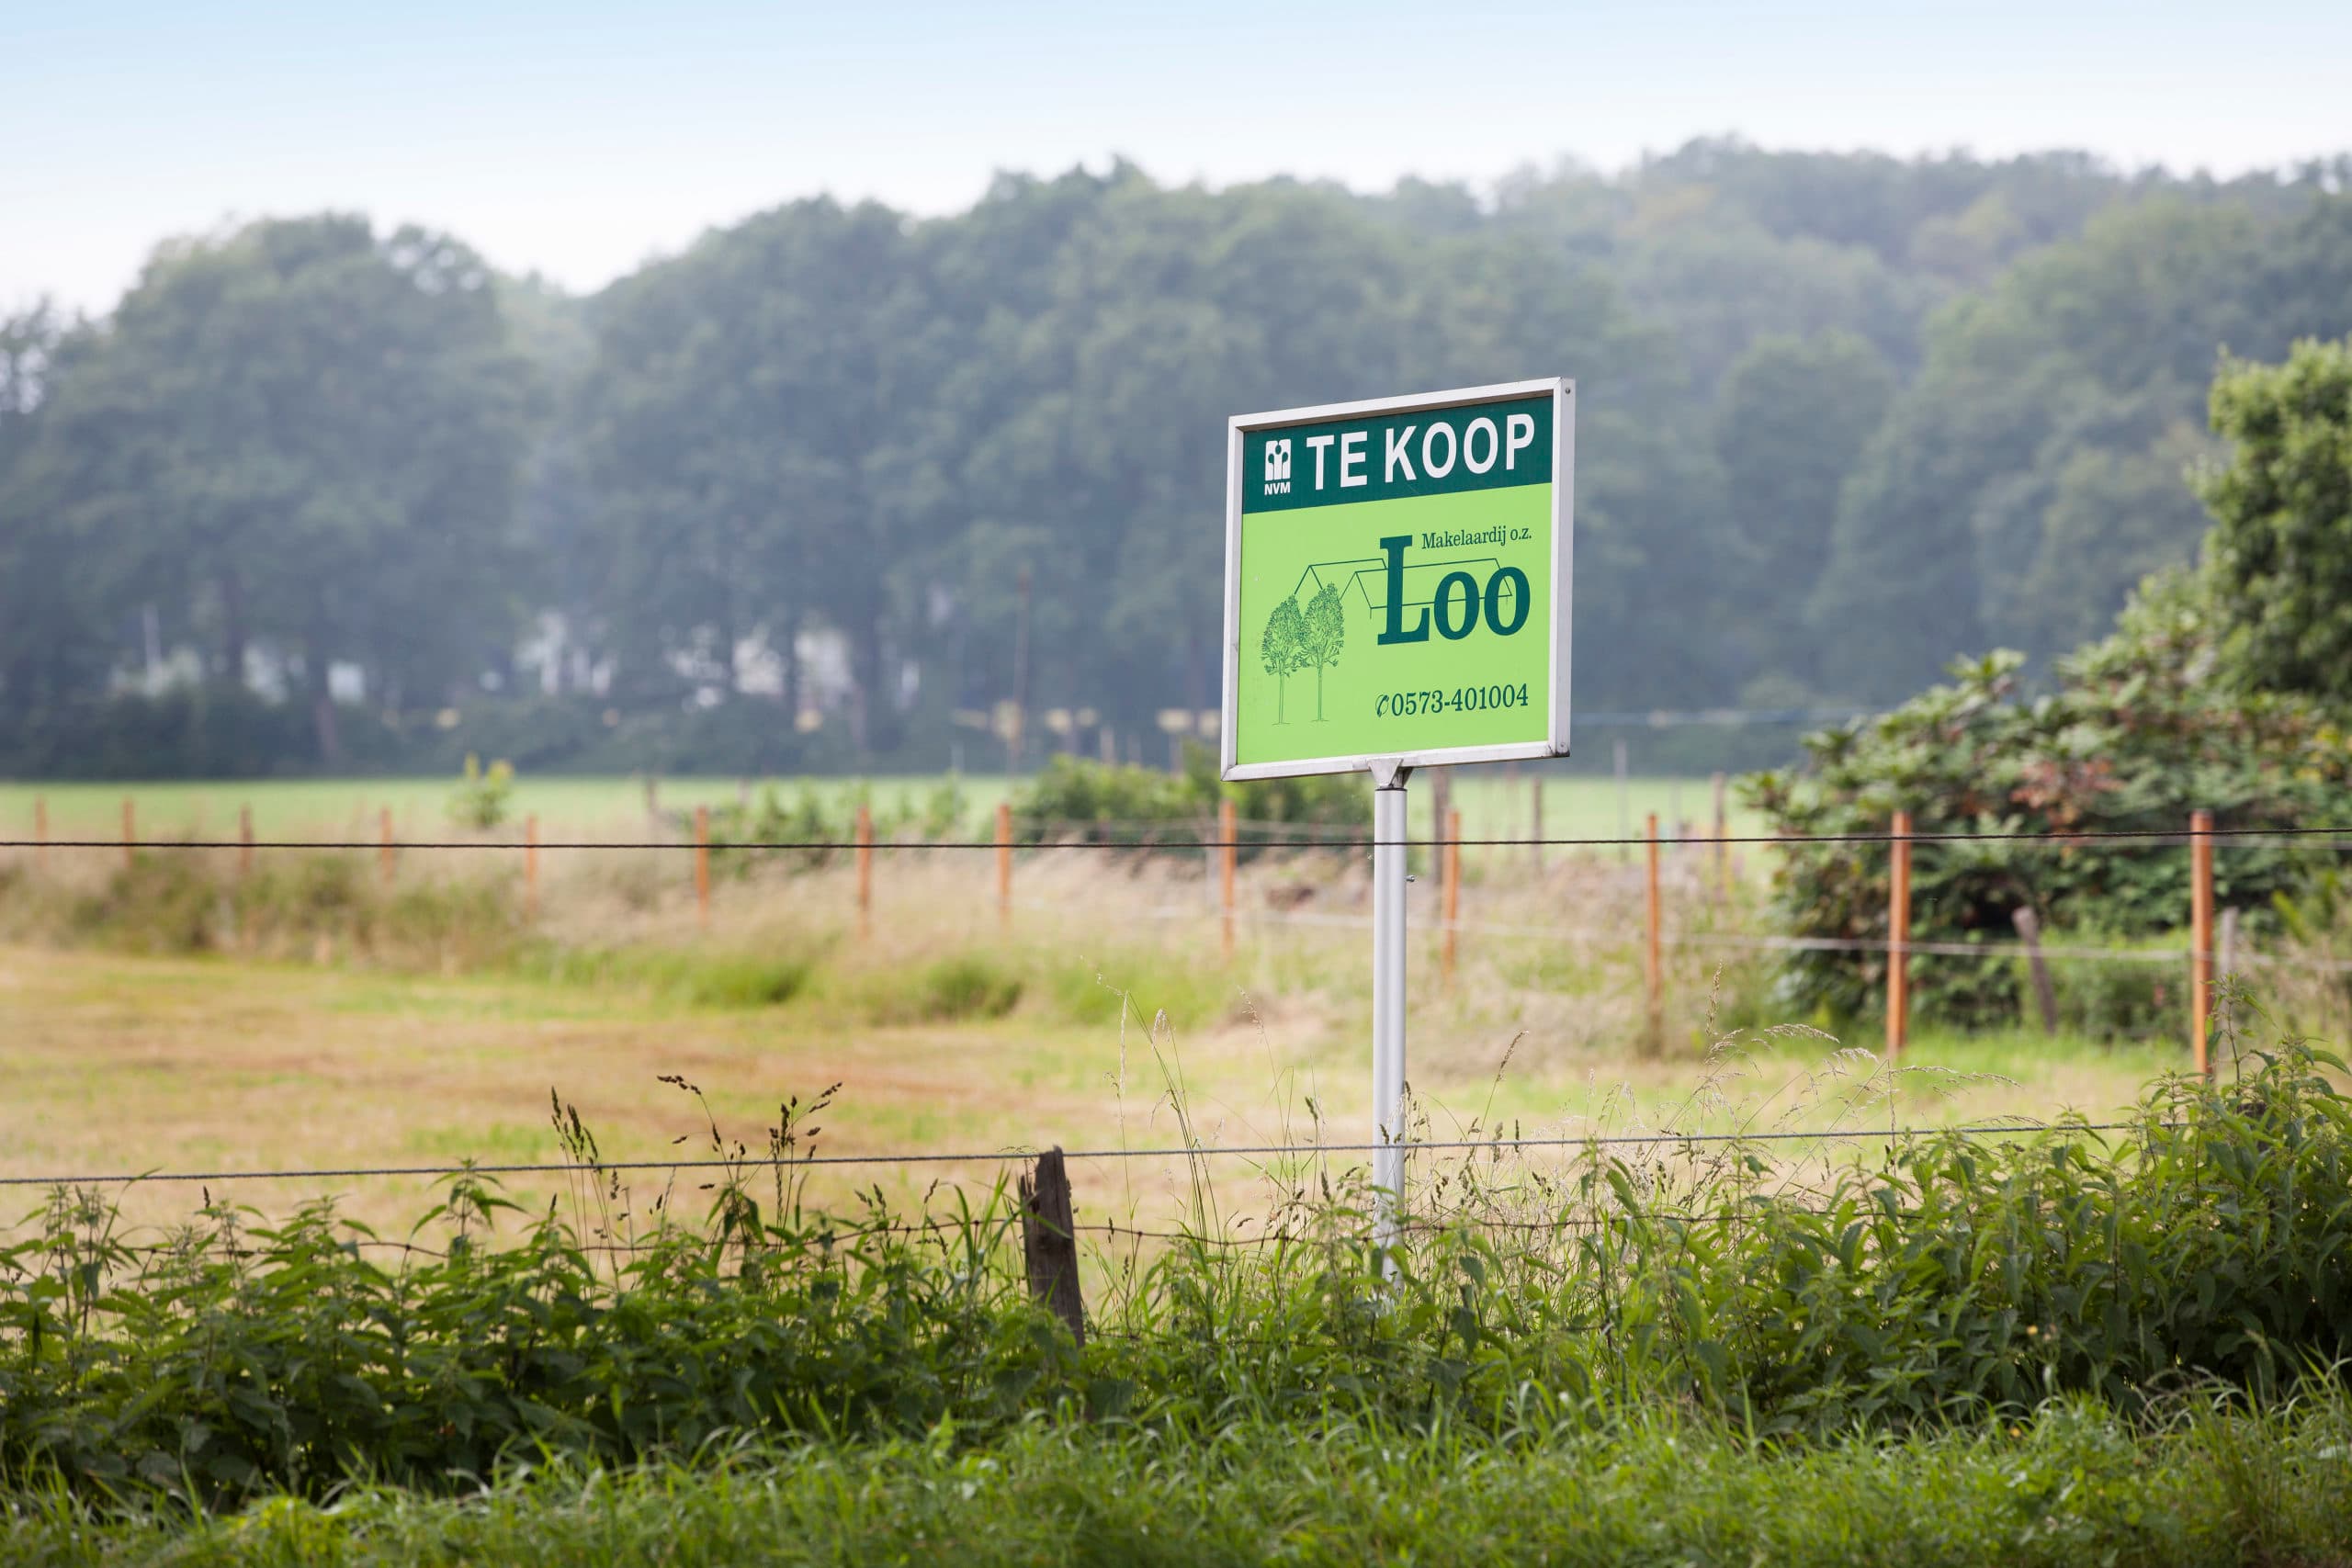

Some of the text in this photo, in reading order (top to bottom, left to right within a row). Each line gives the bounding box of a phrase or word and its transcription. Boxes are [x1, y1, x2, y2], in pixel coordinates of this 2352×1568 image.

[1306, 413, 1535, 491] TE KOOP
[1264, 481, 1291, 496] NVM
[1421, 525, 1532, 549] Makelaardij o.z.
[1377, 535, 1531, 645] Loo
[1391, 683, 1529, 716] 0573-401004
